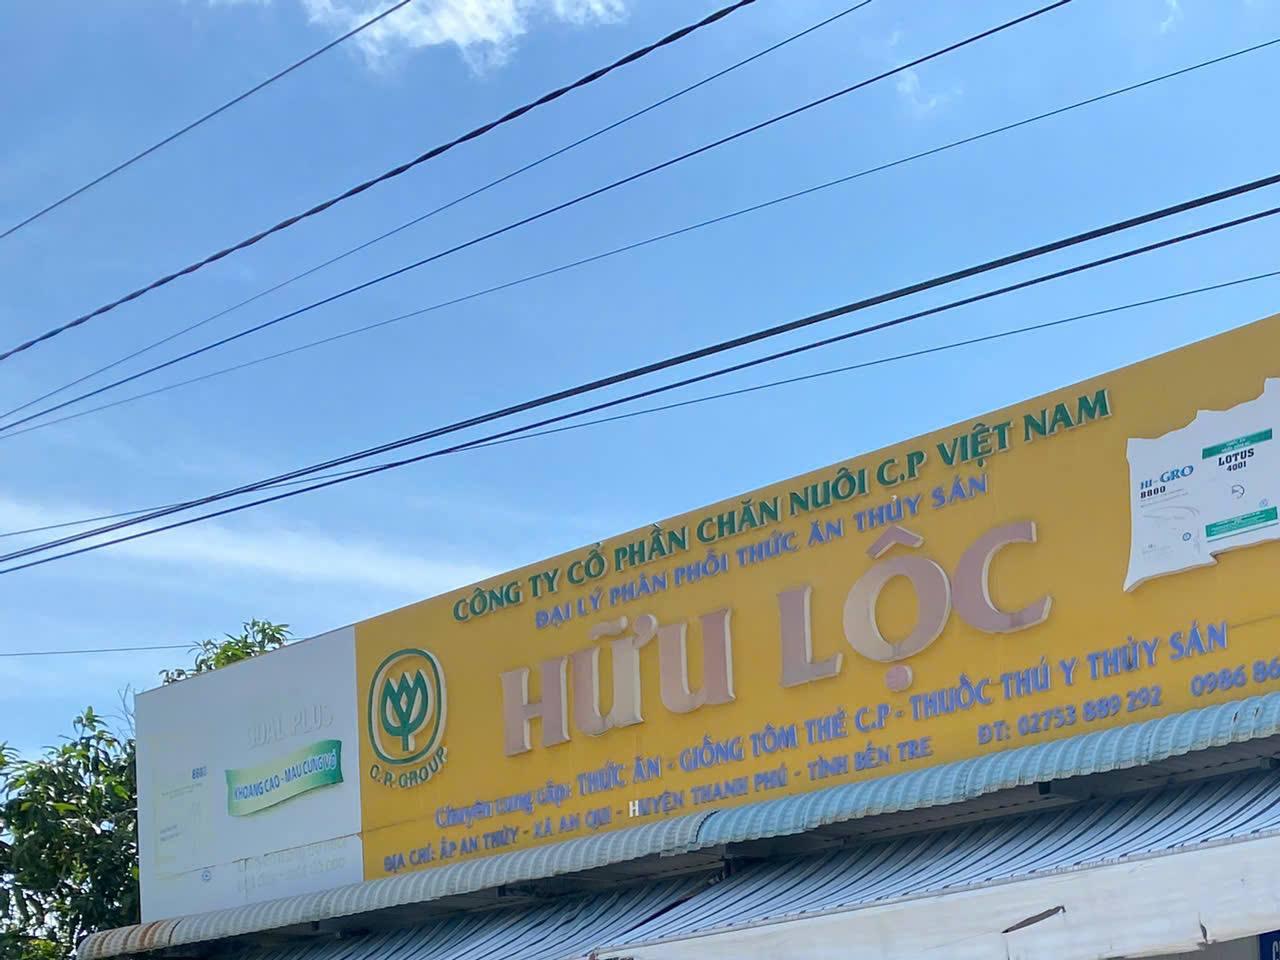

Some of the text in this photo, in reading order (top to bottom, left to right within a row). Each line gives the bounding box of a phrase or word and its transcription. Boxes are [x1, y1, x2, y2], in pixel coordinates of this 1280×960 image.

[453, 388, 1112, 622] CÔNG TY CỔ PHẦN CHĂN NUÔI C.P VIỆT NAM
[1218, 448, 1255, 467] LOTUS
[1226, 461, 1247, 472] 4001
[500, 520, 1053, 757] HỮU LỘC
[536, 602, 573, 631] ĐẠI
[577, 587, 603, 617] LÝ
[674, 548, 729, 585] PHỐI
[736, 529, 799, 567] THỨC
[808, 518, 844, 546] ĂN
[853, 493, 922, 532] THỦY
[931, 472, 988, 508] SẢN
[398, 746, 448, 790] GROUP
[435, 800, 493, 829] Chuyên
[495, 792, 535, 814] cung
[536, 778, 573, 808] cấp:
[577, 760, 627, 796] THỨC
[633, 755, 662, 784] ĂN
[679, 732, 745, 772] GIỐNG
[750, 723, 799, 757] TÔM
[804, 706, 849, 745] THẺ
[855, 703, 891, 733] C.P
[909, 673, 993, 721] THUỐC
[1000, 656, 1050, 700] THÚ
[1059, 657, 1078, 686] Y
[1087, 636, 1160, 680] THỦY
[1169, 620, 1228, 661] SẢN
[459, 834, 479, 855] AN
[559, 812, 580, 833] AN
[754, 762, 788, 793] PHÚ
[854, 740, 892, 772] BẾN
[896, 736, 934, 762] TRE
[1190, 664, 1248, 697] 0986
